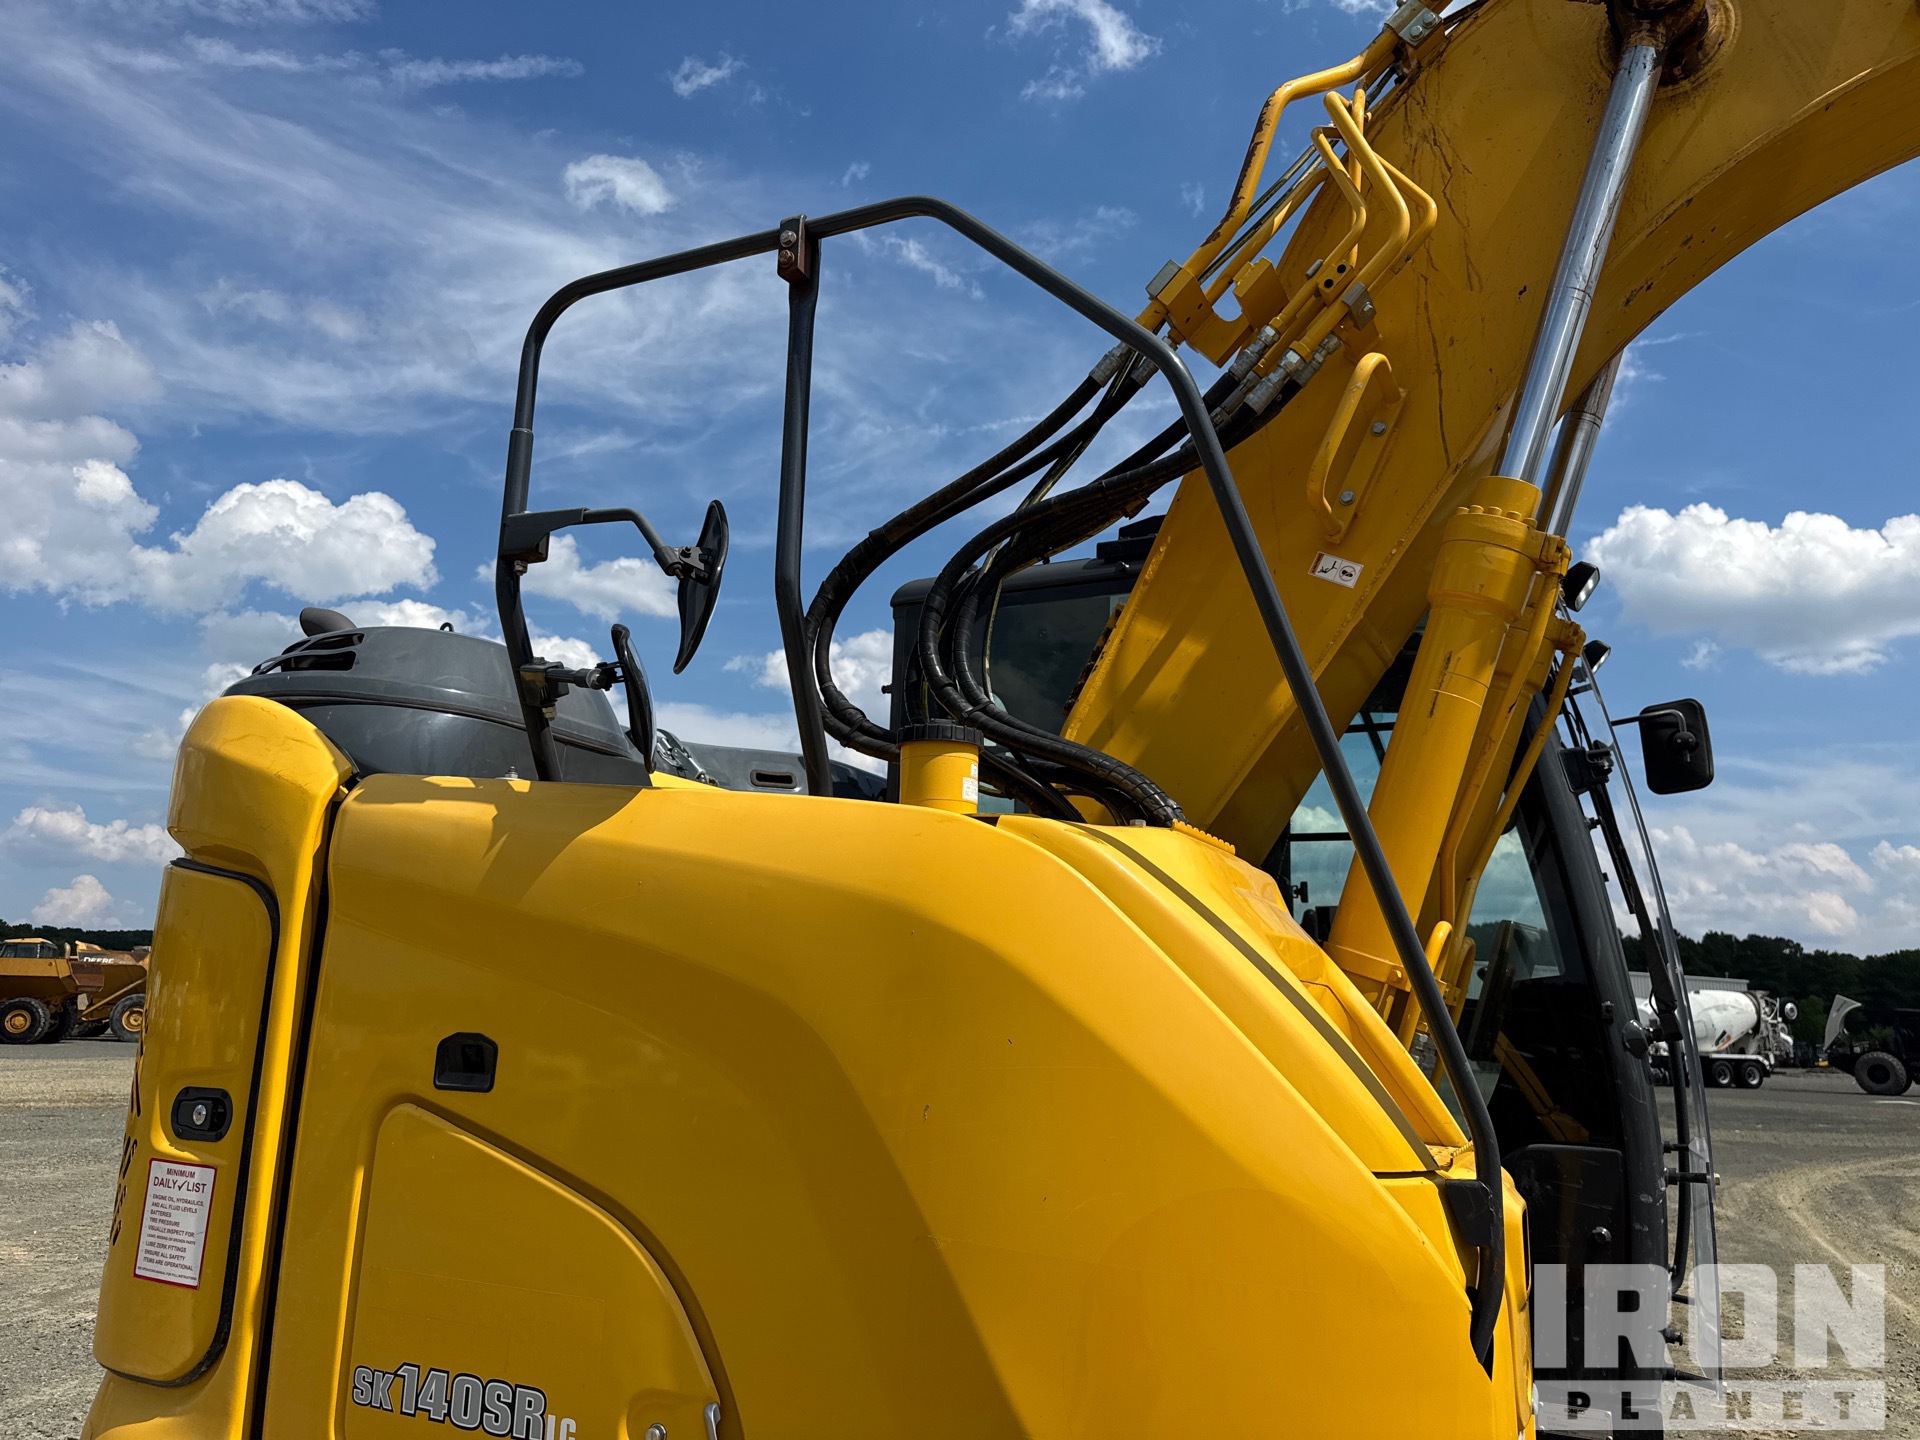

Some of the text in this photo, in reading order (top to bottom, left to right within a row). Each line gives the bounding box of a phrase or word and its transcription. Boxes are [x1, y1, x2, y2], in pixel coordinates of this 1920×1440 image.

[167, 1168, 195, 1178] MINIMUM
[150, 1209, 171, 1217] BATTERIES
[159, 1219, 180, 1227] PRESSURE
[148, 1225, 166, 1233] VISUALLY
